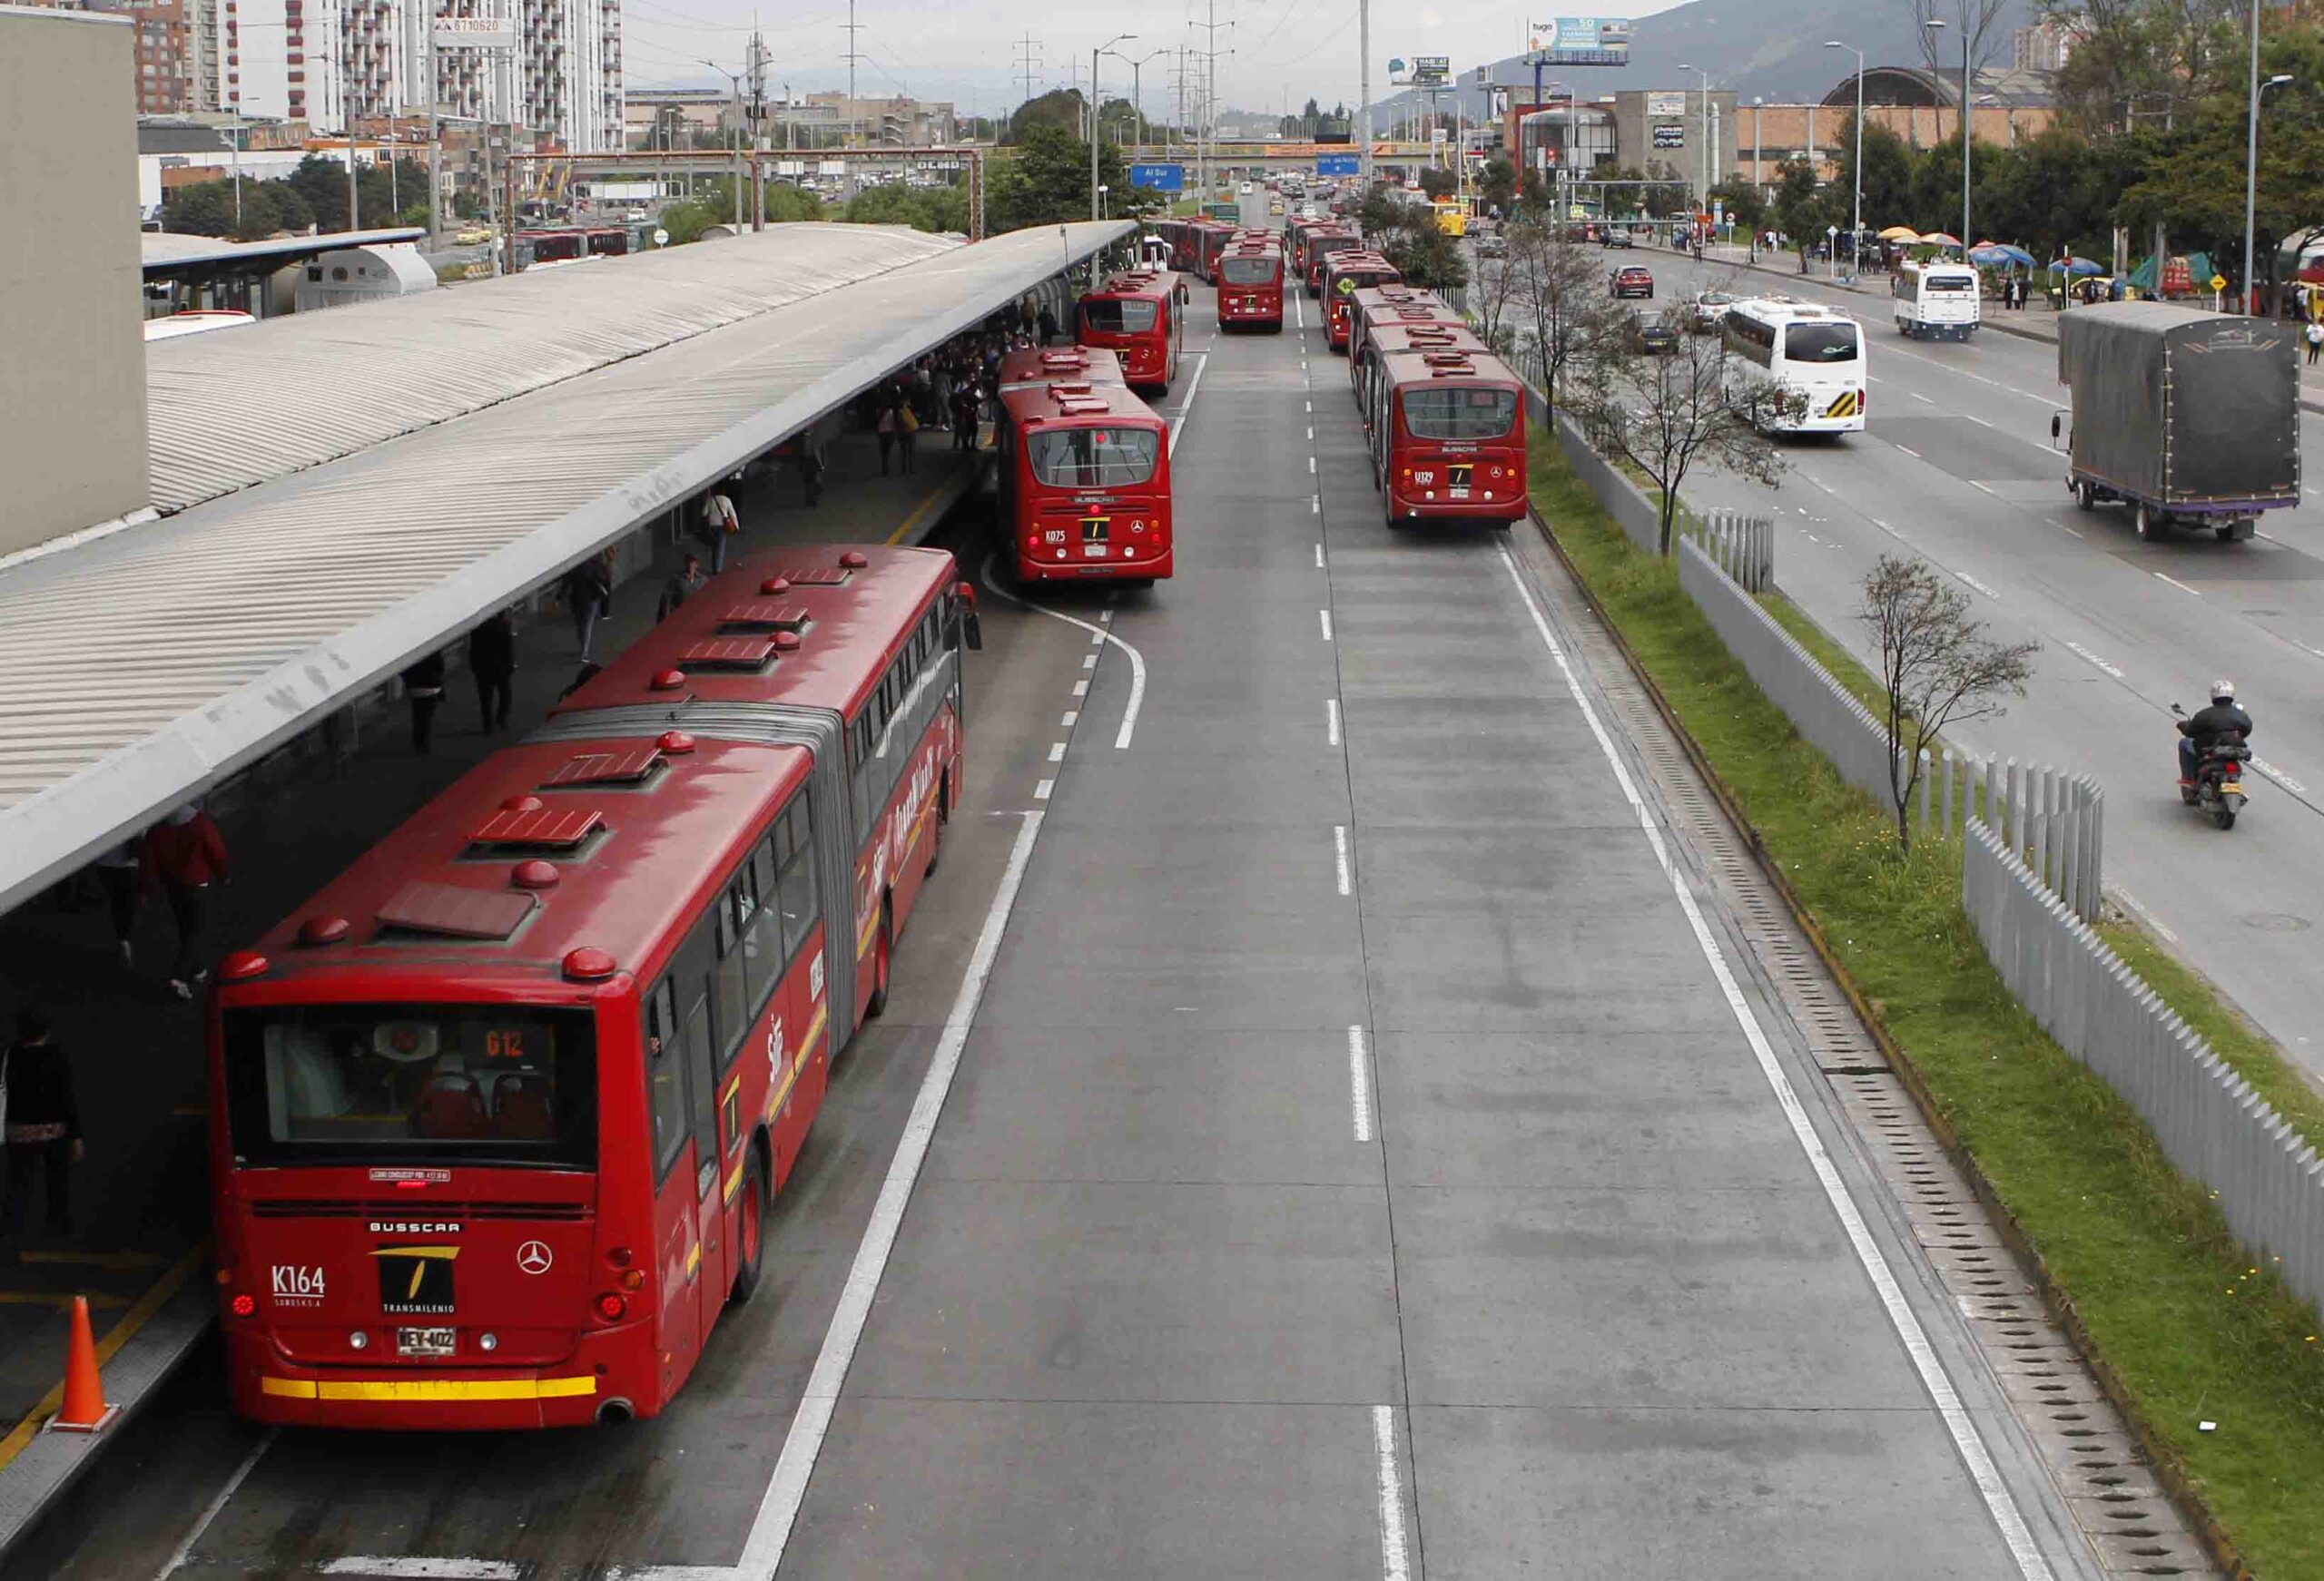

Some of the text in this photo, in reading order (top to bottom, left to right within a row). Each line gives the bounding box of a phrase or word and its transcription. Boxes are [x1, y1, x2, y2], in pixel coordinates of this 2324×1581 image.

[1532, 23, 1553, 32] tugo
[1414, 471, 1433, 483] U129
[1046, 530, 1066, 543] K075
[369, 1223, 460, 1232] BUSSCAR
[271, 1265, 325, 1294] K164
[383, 1303, 455, 1313] TRANSMILENIO
